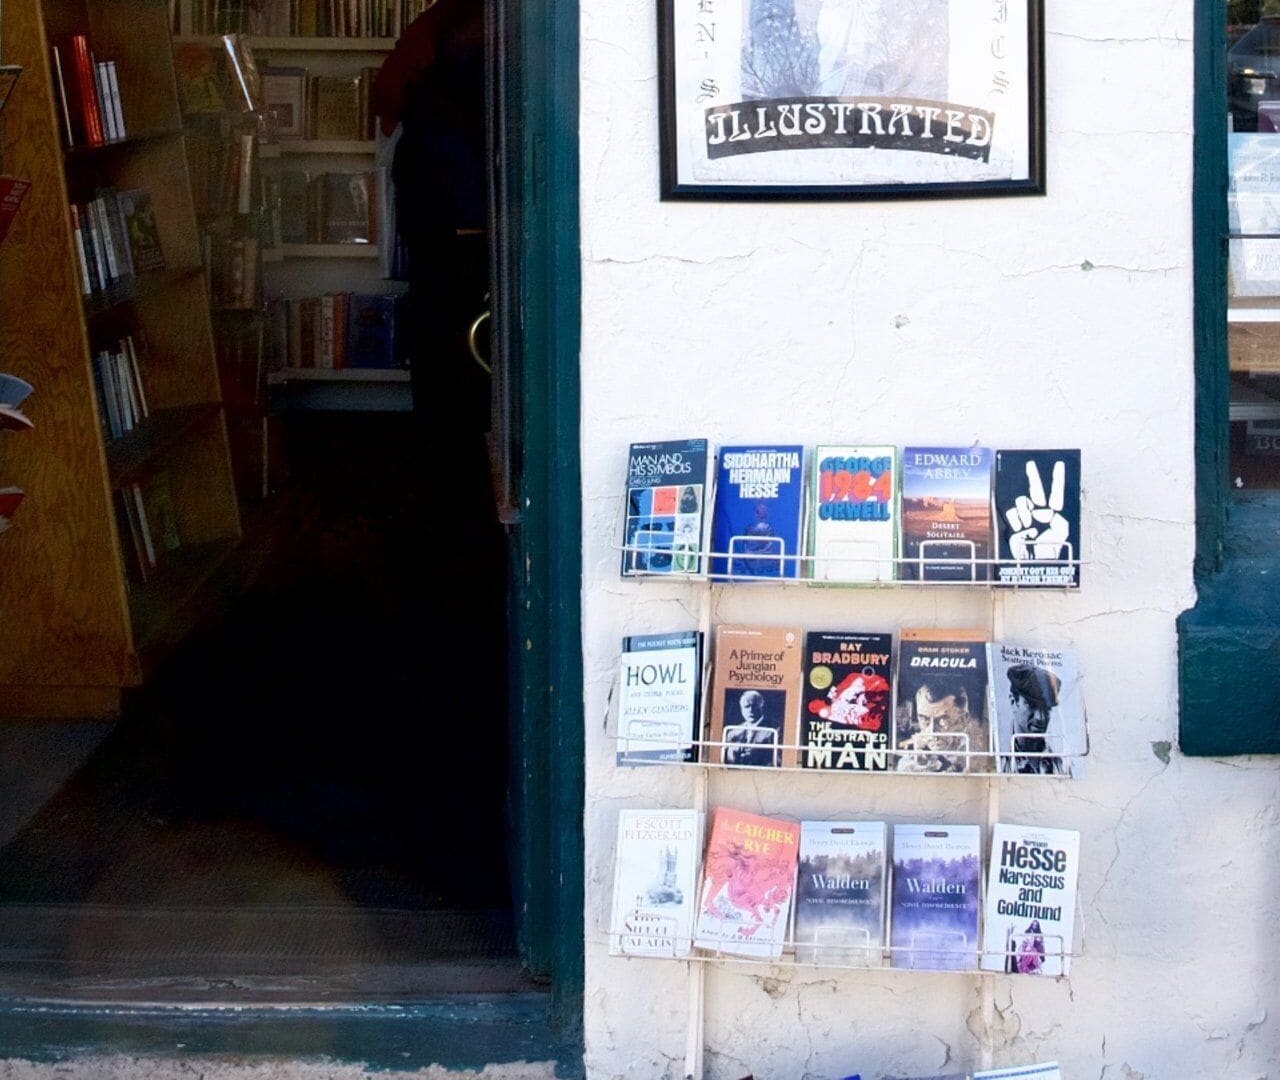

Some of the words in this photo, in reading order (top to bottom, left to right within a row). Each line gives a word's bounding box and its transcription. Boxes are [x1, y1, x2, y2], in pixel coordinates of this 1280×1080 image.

[708, 103, 991, 146] ILLUSTRATED
[631, 455, 657, 465] MAN
[656, 452, 682, 463] AND
[723, 453, 799, 469] SIDDHARTHA
[820, 456, 891, 473] GEORGE
[914, 453, 981, 466] EDWARD
[629, 465, 646, 476] HIS
[647, 462, 691, 475] SYMBOLS
[729, 469, 790, 484] HERMANN
[924, 468, 969, 479] ABBEY
[739, 483, 778, 498] HESSE
[820, 471, 891, 503] 1984
[819, 501, 890, 521] ORWELL
[932, 522, 960, 530] DESERT
[840, 643, 862, 651] RAY
[1000, 645, 1020, 656] Jack
[1022, 649, 1062, 659] Kerouac
[730, 649, 738, 660] A
[740, 650, 772, 660] Primer
[774, 651, 785, 661] of
[812, 652, 889, 665] BRADBURY
[910, 656, 977, 668] DRACULA
[626, 663, 686, 686] HOWL
[735, 661, 776, 673] Jungian
[729, 671, 784, 684] Psychology
[809, 722, 832, 731] THE
[808, 731, 887, 742] ILLUSTRATED
[807, 741, 887, 768] MAN
[625, 830, 692, 841] FITZGERALD
[735, 821, 794, 844] CATCHER
[744, 839, 774, 854] RYE
[1001, 841, 1067, 872] Hesse
[812, 874, 869, 890] Walden
[907, 878, 965, 894] Walden
[999, 868, 1064, 890] Narcissus
[1018, 887, 1042, 903] and
[997, 900, 1061, 921] Goldmund
